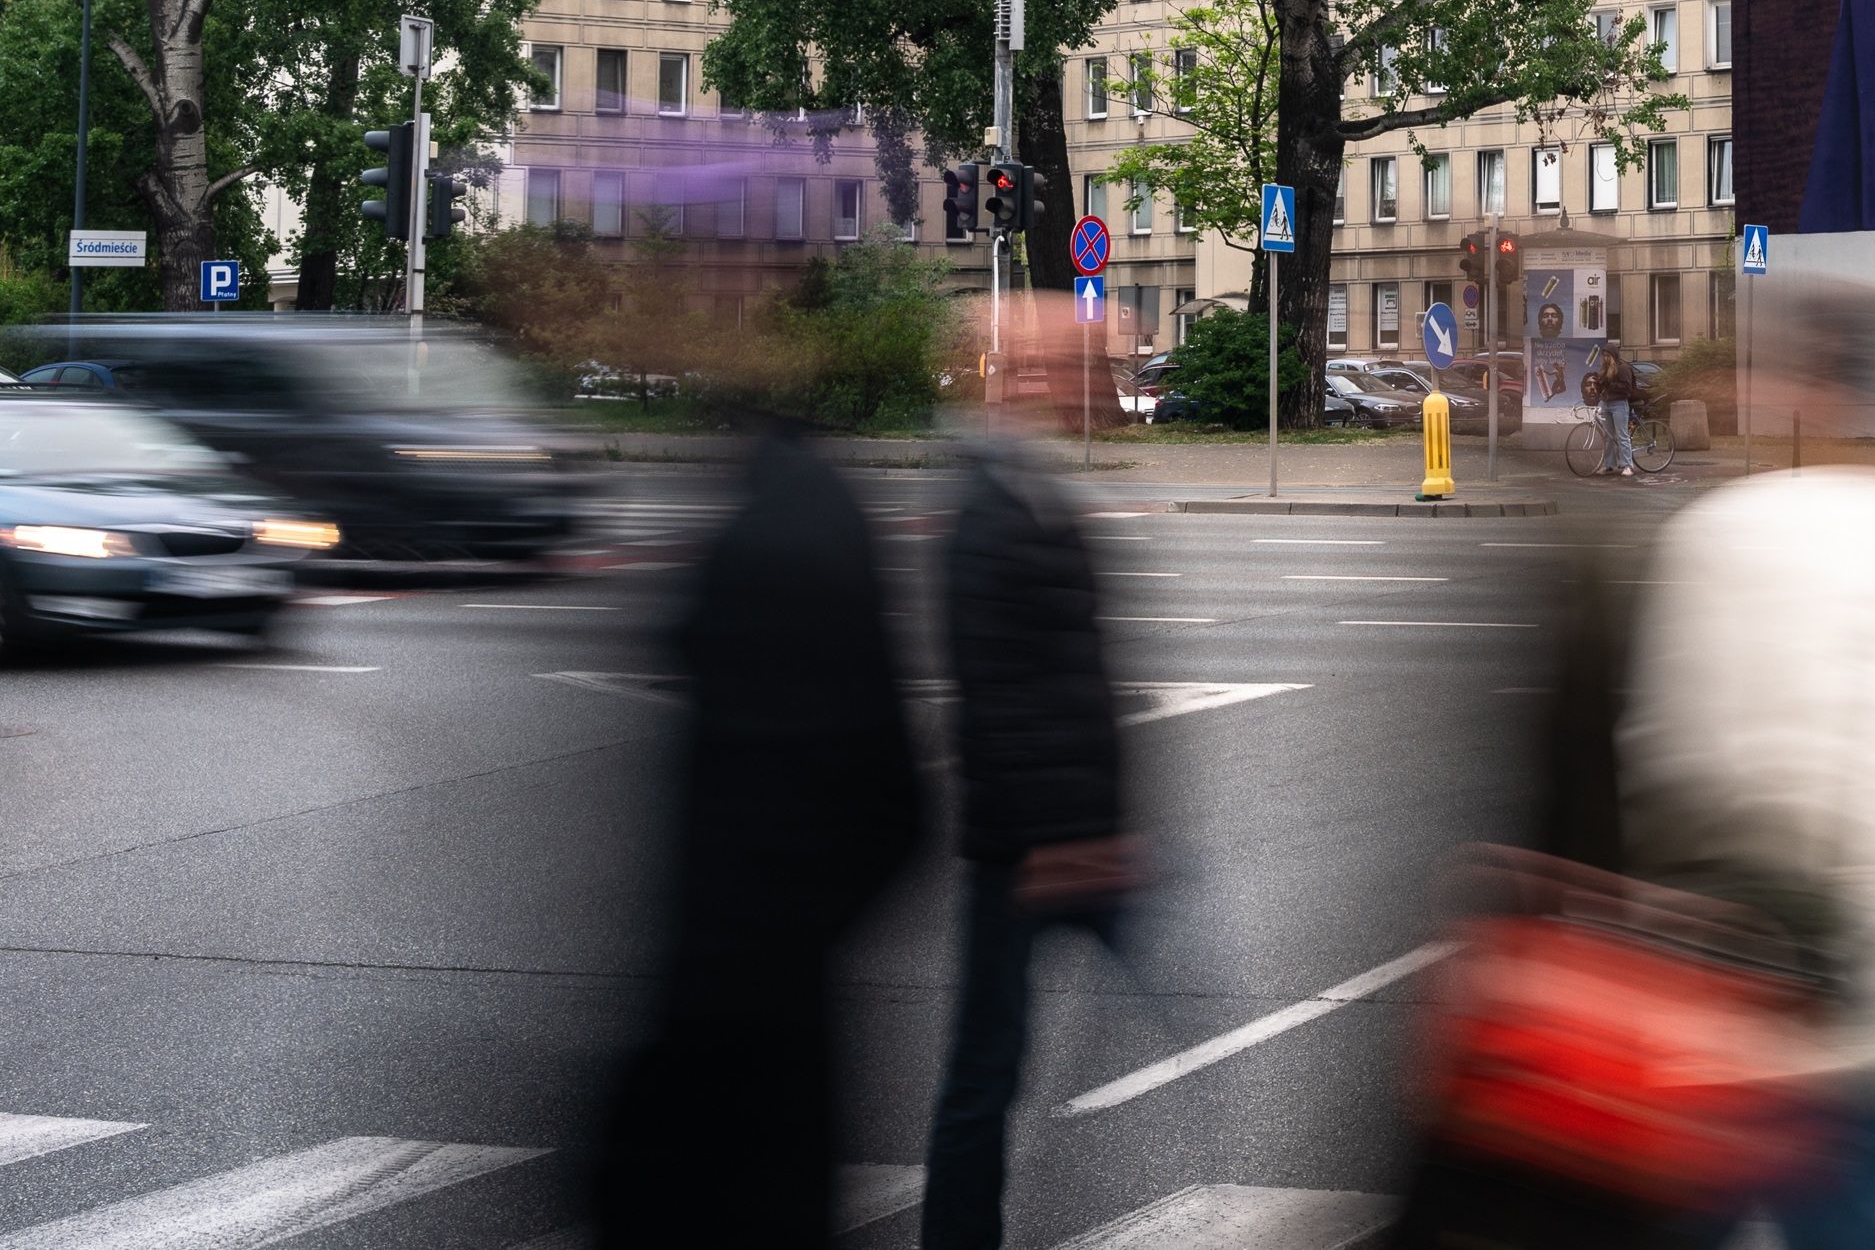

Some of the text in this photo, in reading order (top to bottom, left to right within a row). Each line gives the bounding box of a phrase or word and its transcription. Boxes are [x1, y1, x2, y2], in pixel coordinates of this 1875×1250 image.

[76, 238, 138, 254] Śródmieście
[211, 265, 231, 296] P
[1587, 274, 1600, 286] air
